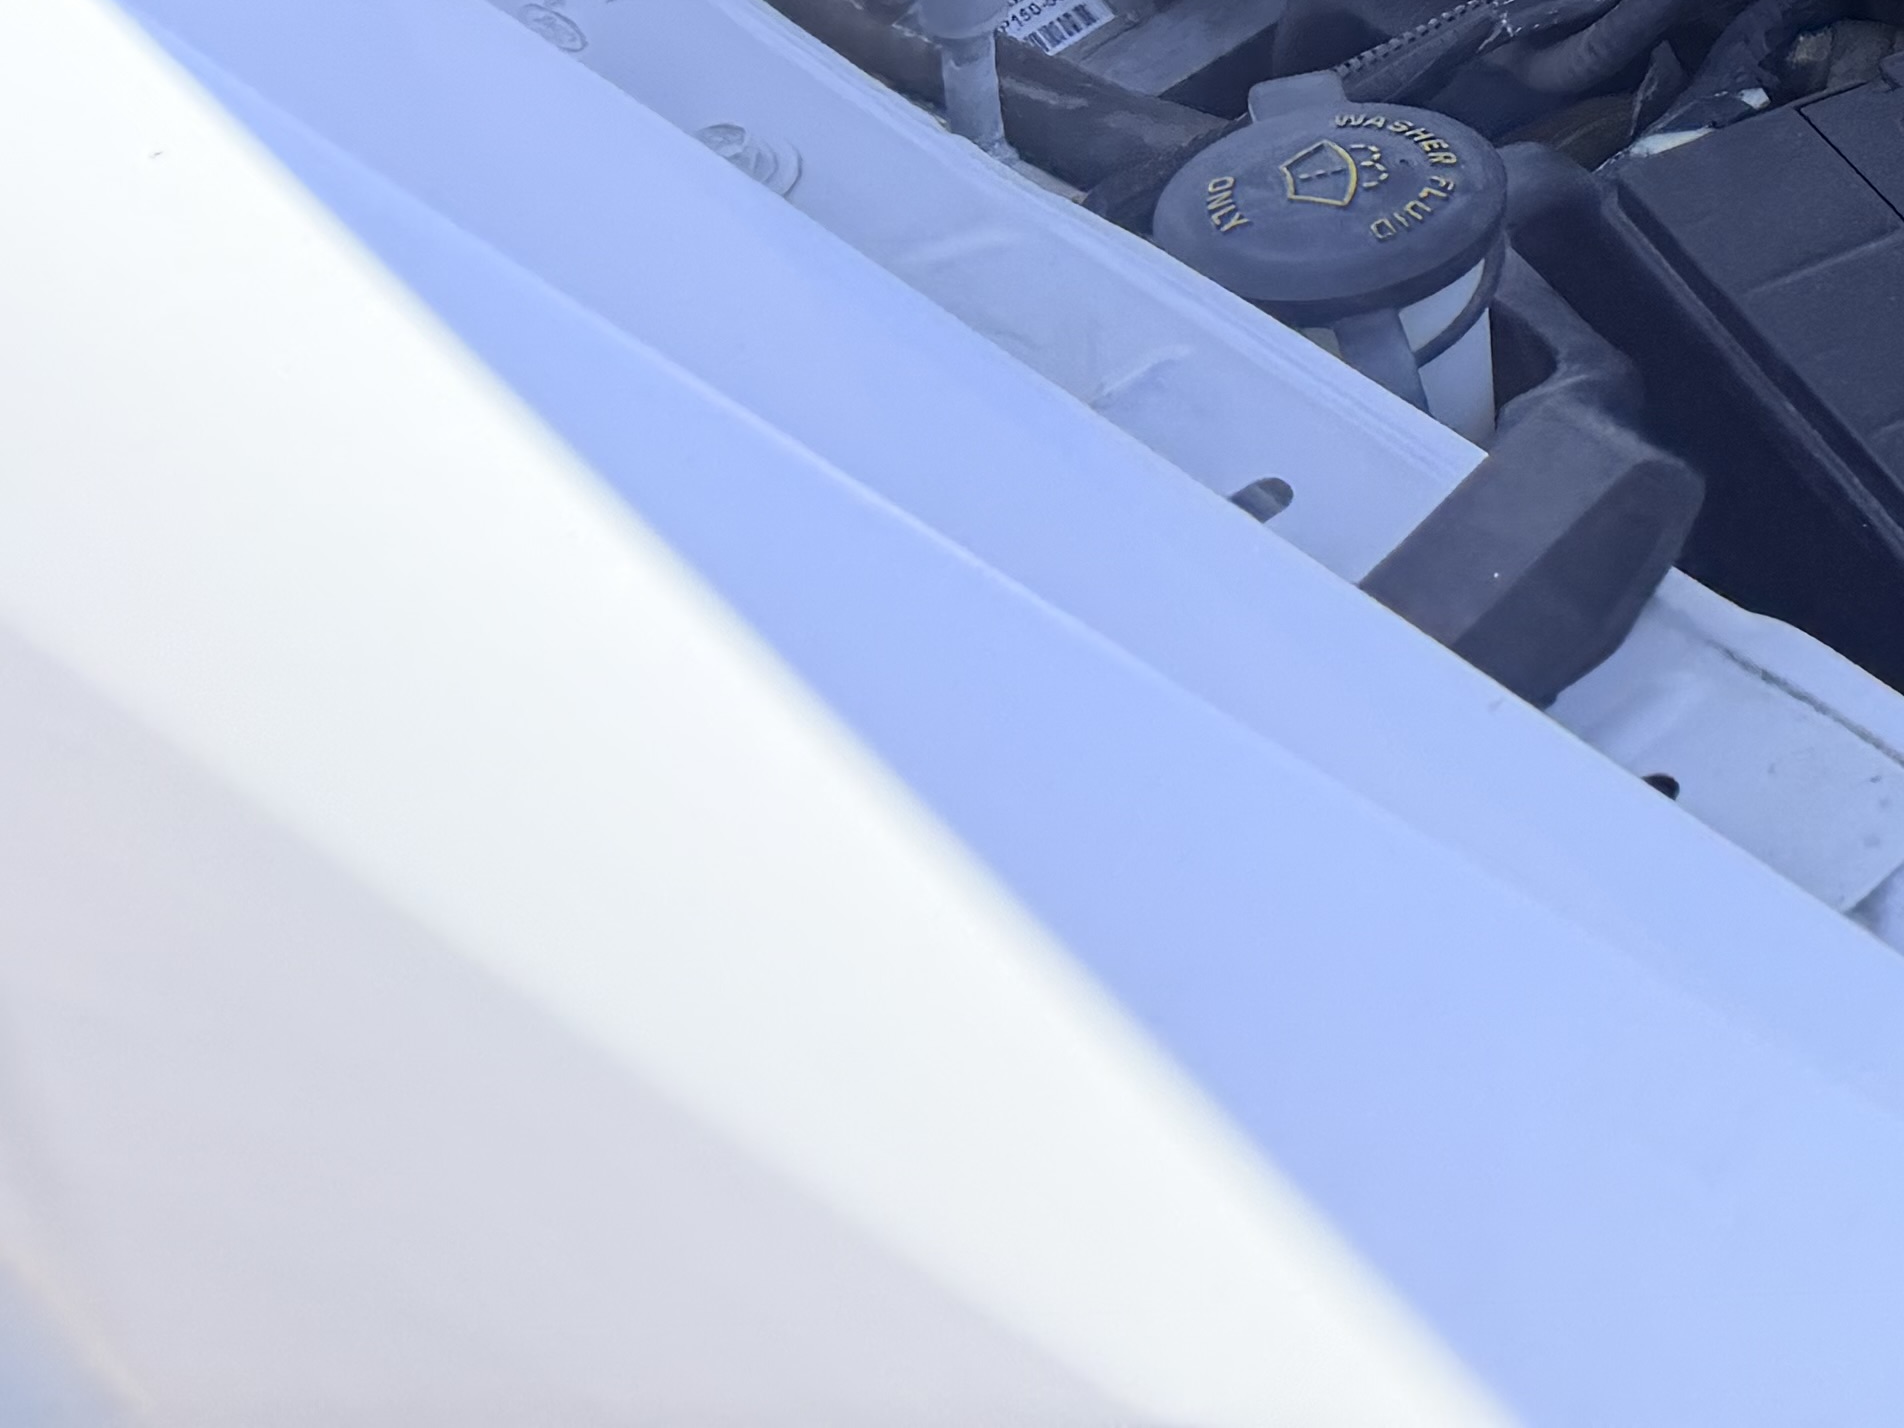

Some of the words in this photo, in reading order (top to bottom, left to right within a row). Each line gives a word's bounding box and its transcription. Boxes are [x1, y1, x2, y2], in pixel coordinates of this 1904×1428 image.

[1335, 114, 1457, 166] WASHER
[1207, 175, 1250, 234] ONLY
[1369, 175, 1456, 242] FLUID
